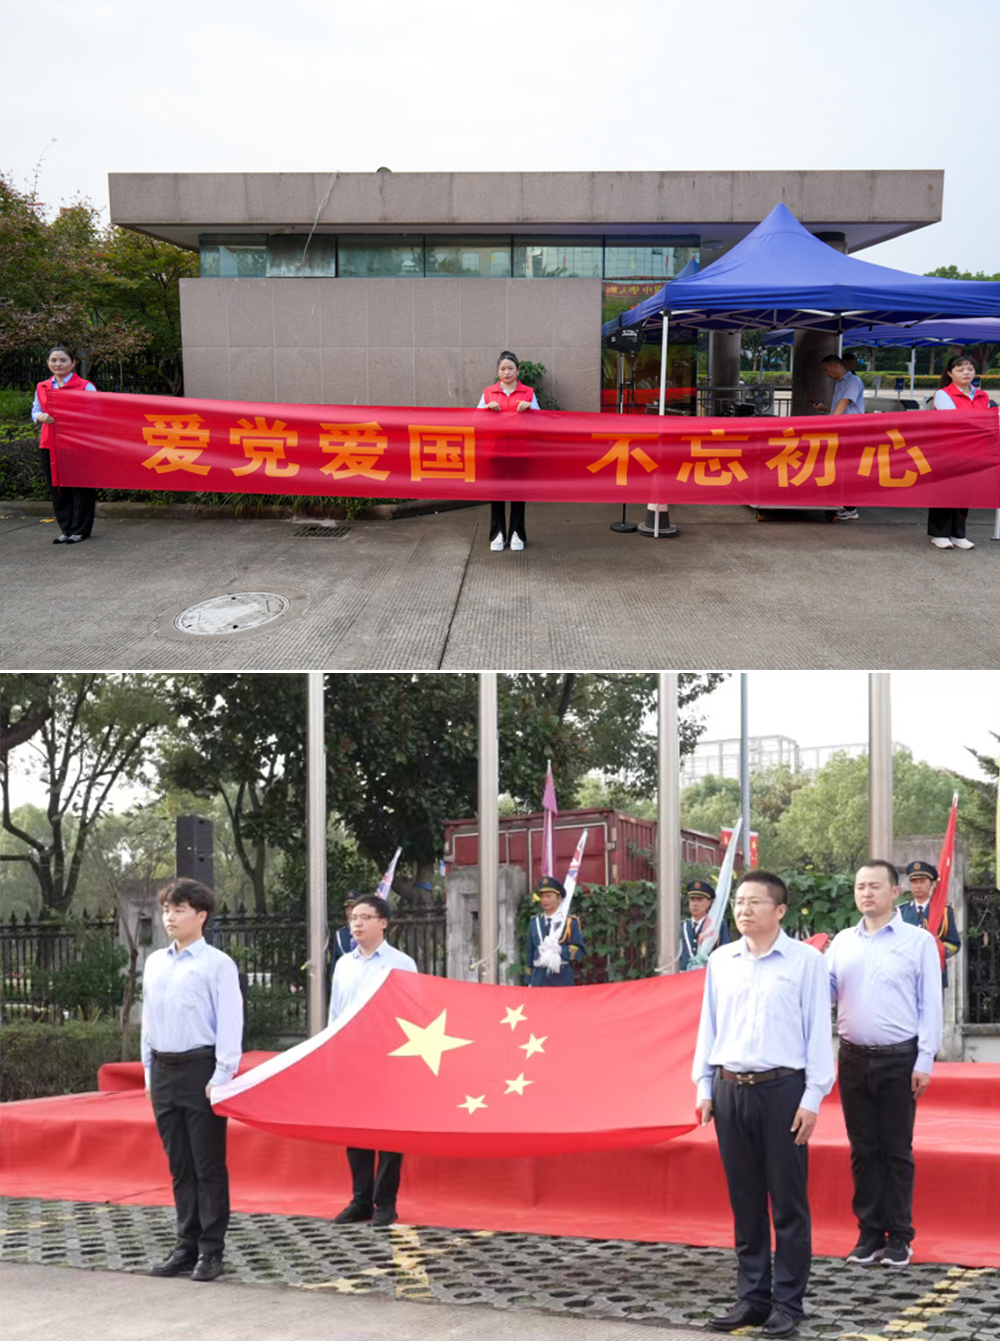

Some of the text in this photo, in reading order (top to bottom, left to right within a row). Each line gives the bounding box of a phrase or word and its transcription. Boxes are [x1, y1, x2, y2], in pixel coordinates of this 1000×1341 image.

[141, 413, 932, 488] 爱党爱国 不忘初心
